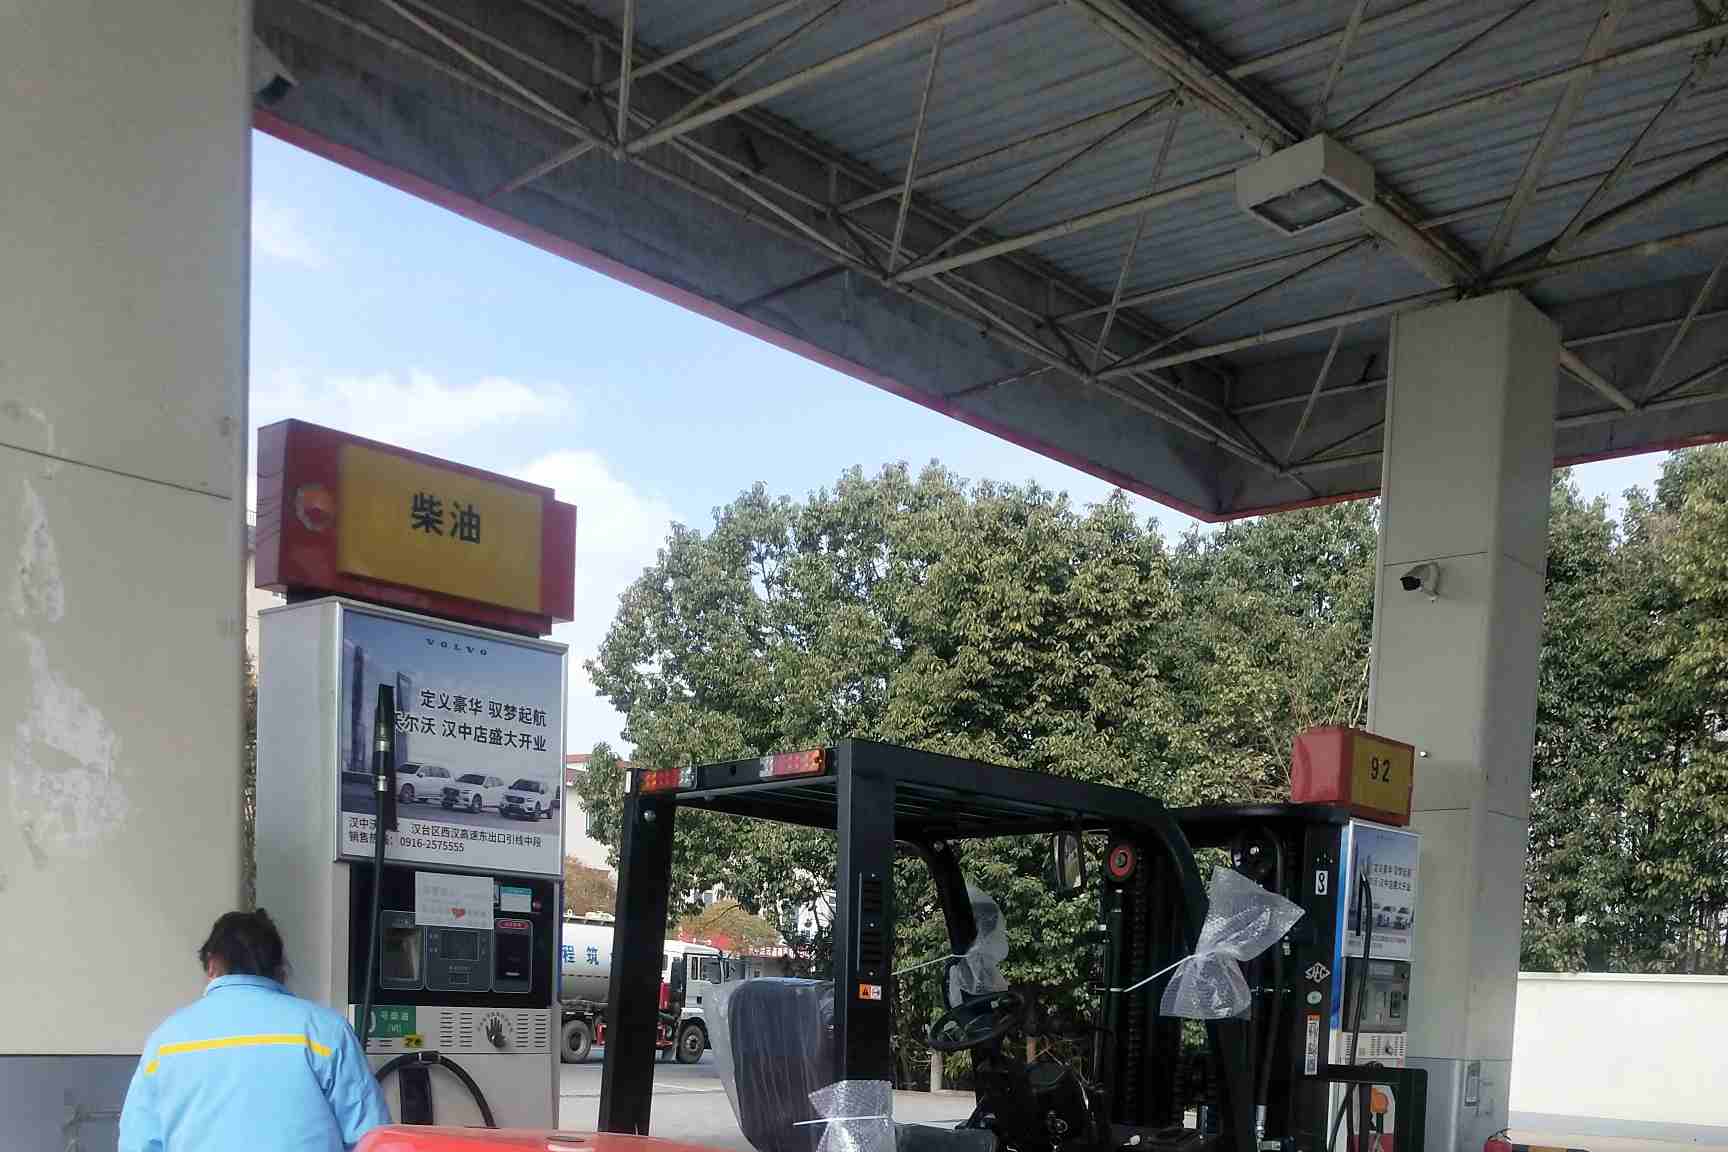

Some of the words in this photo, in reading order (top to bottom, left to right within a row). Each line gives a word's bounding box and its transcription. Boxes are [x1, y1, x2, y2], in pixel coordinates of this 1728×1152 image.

[411, 491, 481, 545] 柴油
[425, 637, 488, 656] VOLVO
[420, 689, 483, 717] 定义豪华
[488, 700, 548, 728] 驭梦起航
[441, 721, 548, 753] 汉中店盛大开业
[1370, 757, 1392, 783] 92
[400, 836, 465, 853] 0916-2575555
